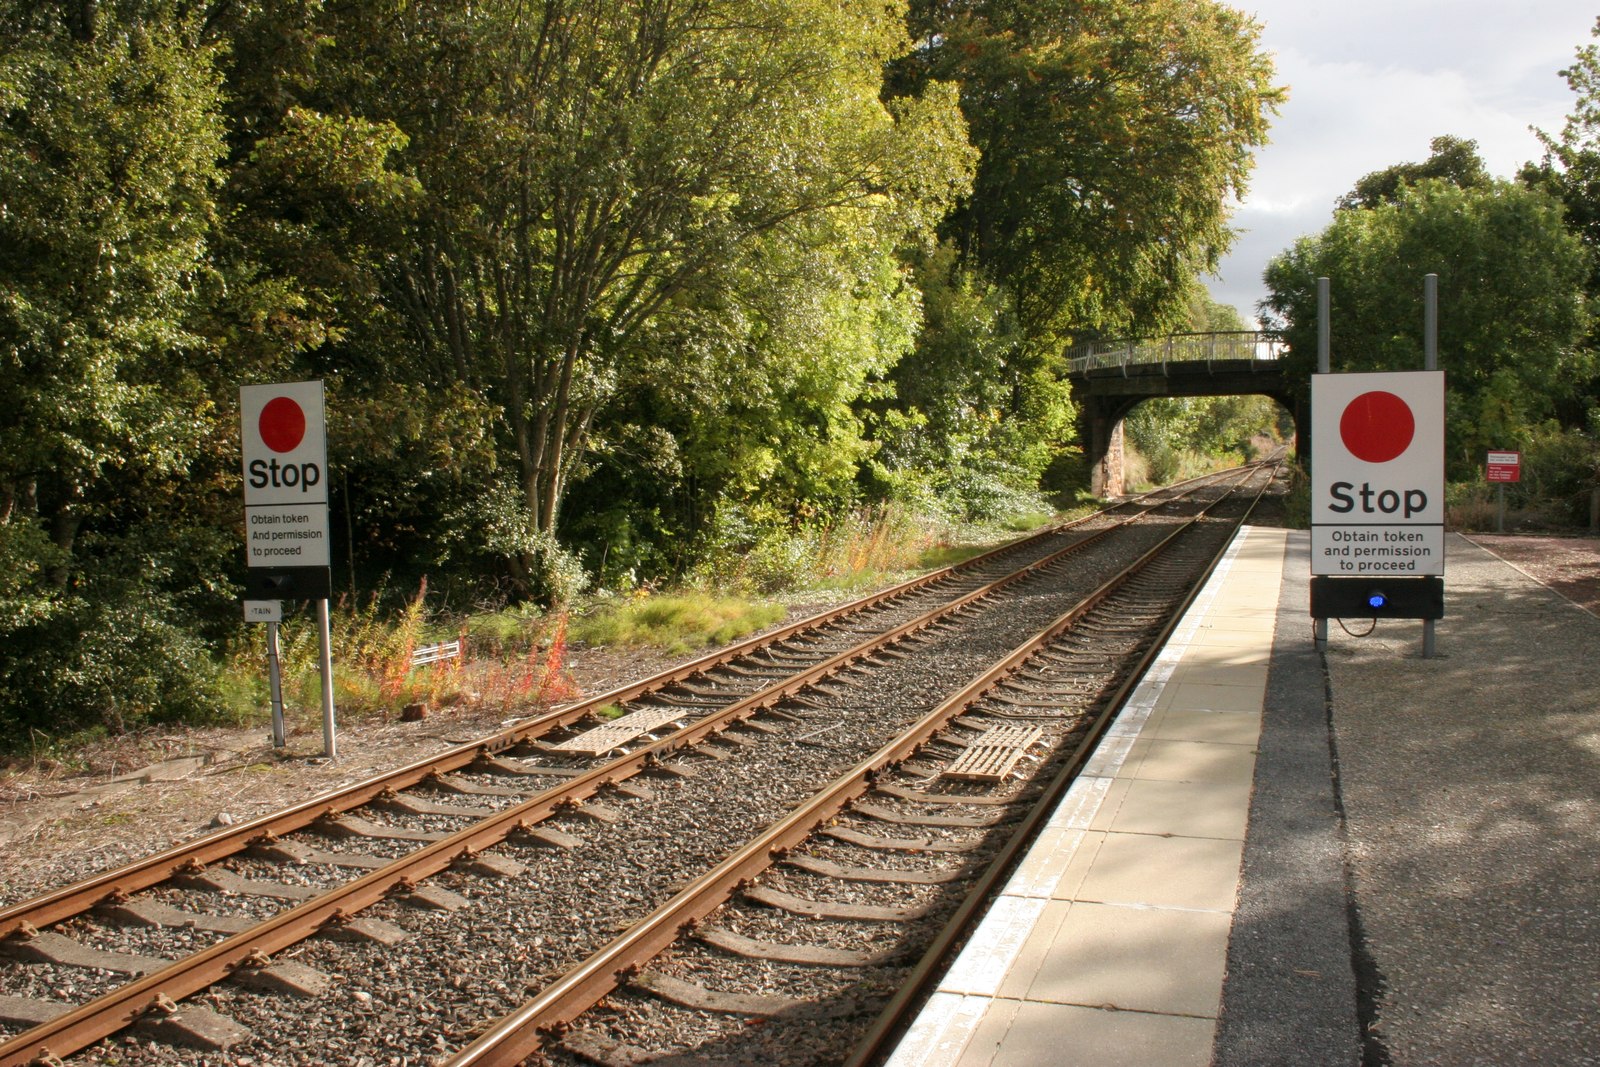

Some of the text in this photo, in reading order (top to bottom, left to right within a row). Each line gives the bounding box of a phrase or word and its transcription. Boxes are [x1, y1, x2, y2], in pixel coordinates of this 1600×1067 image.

[249, 458, 320, 492] Stop
[1328, 481, 1428, 519] Stop
[251, 514, 309, 525] Obtain token
[252, 529, 322, 541] And permission
[1331, 531, 1424, 542] Obtain token
[253, 546, 302, 557] to proceed
[1324, 545, 1431, 558] and permission
[1340, 560, 1416, 572] to proceed
